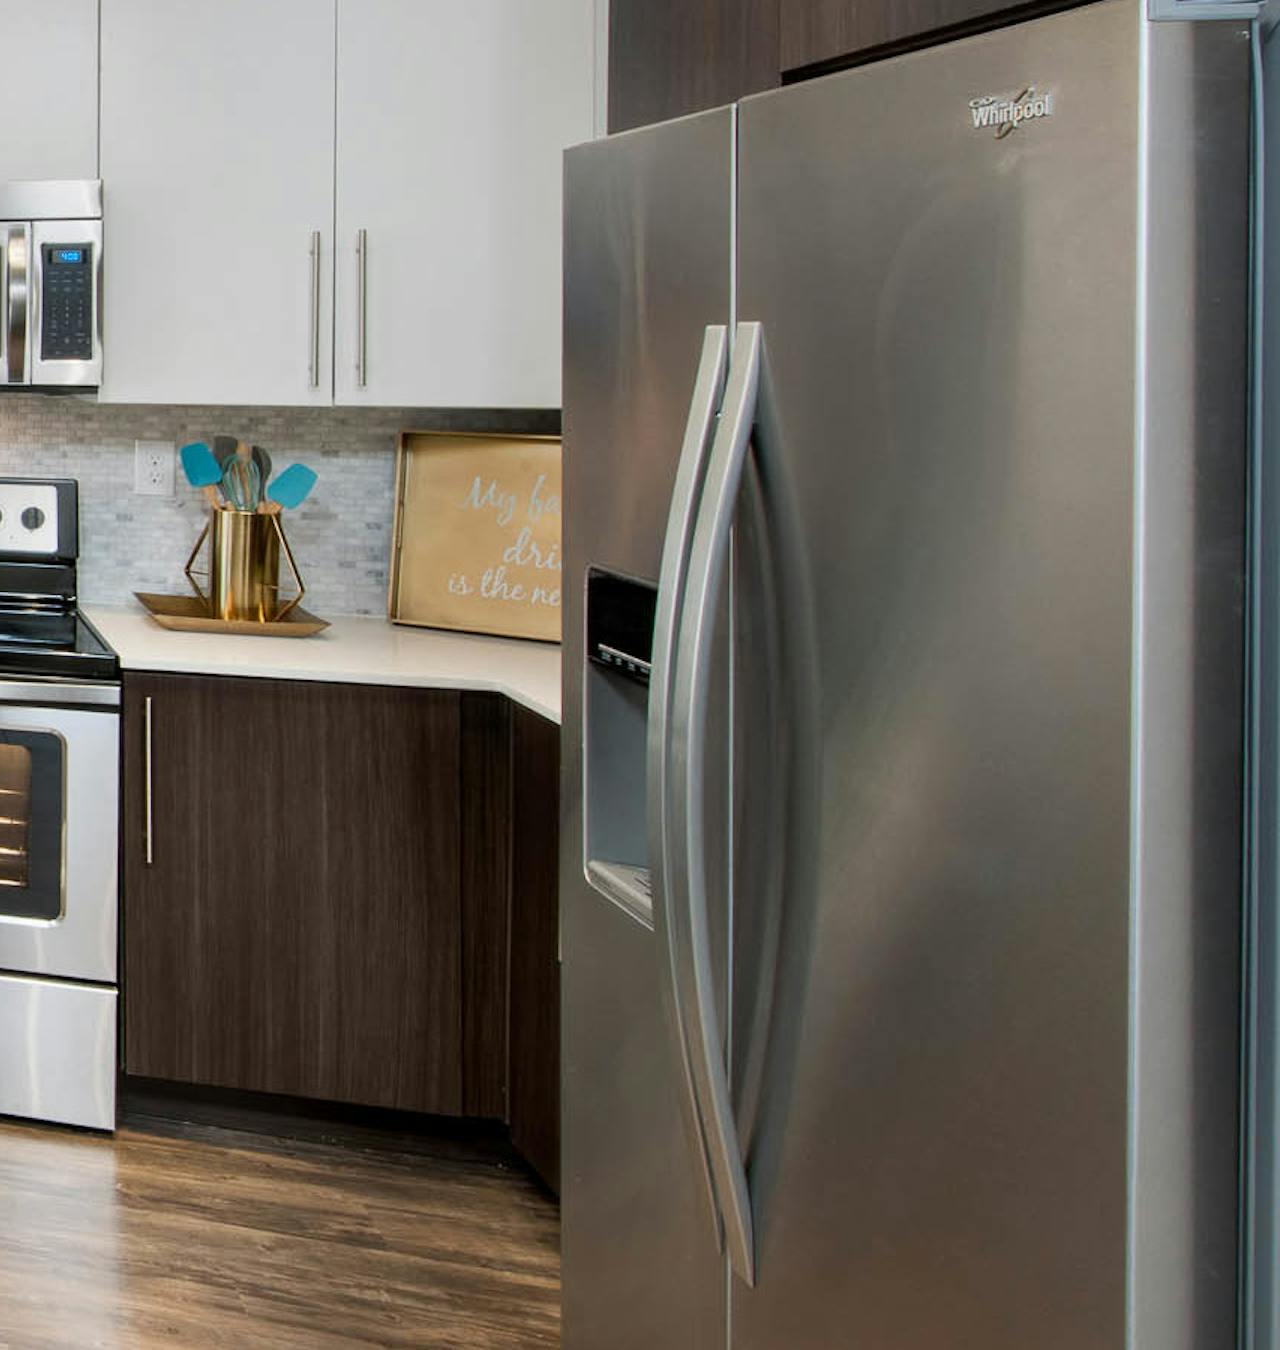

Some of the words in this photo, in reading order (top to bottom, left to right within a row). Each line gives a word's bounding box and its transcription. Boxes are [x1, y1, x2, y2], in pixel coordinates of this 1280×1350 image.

[970, 91, 1052, 130] Whirlpool
[459, 475, 517, 526] My
[502, 527, 562, 569] dri
[448, 573, 474, 595] is
[480, 566, 527, 600] the
[532, 586, 561, 607] ne
